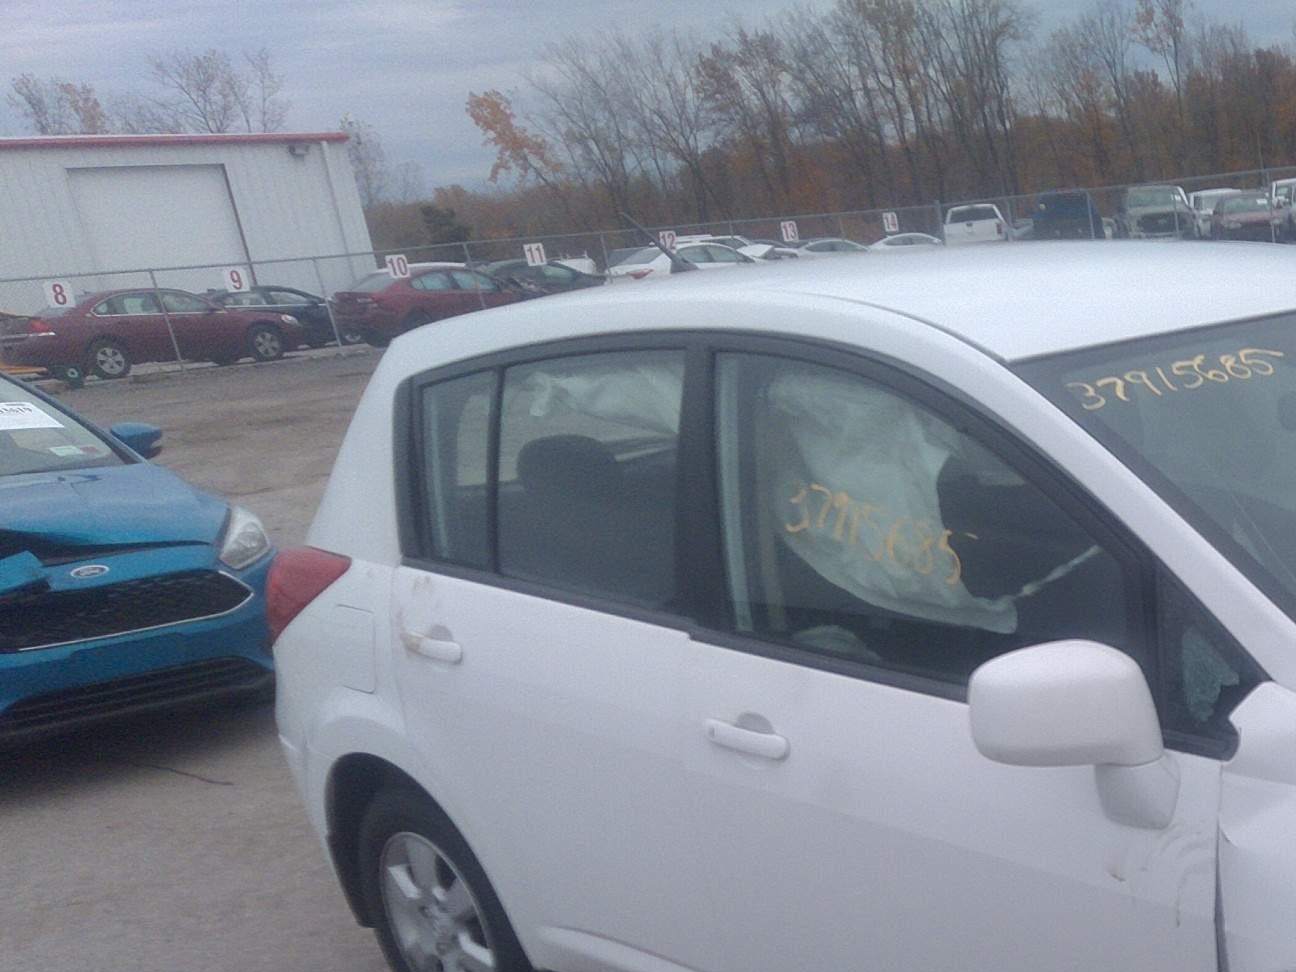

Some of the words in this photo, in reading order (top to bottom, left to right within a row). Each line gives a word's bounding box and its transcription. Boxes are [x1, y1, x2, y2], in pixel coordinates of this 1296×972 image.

[783, 222, 796, 240] 13
[526, 245, 545, 263] 11
[388, 257, 408, 277] 10
[229, 270, 243, 289] 9
[52, 283, 68, 305] 8
[1067, 348, 1284, 410] 37915685
